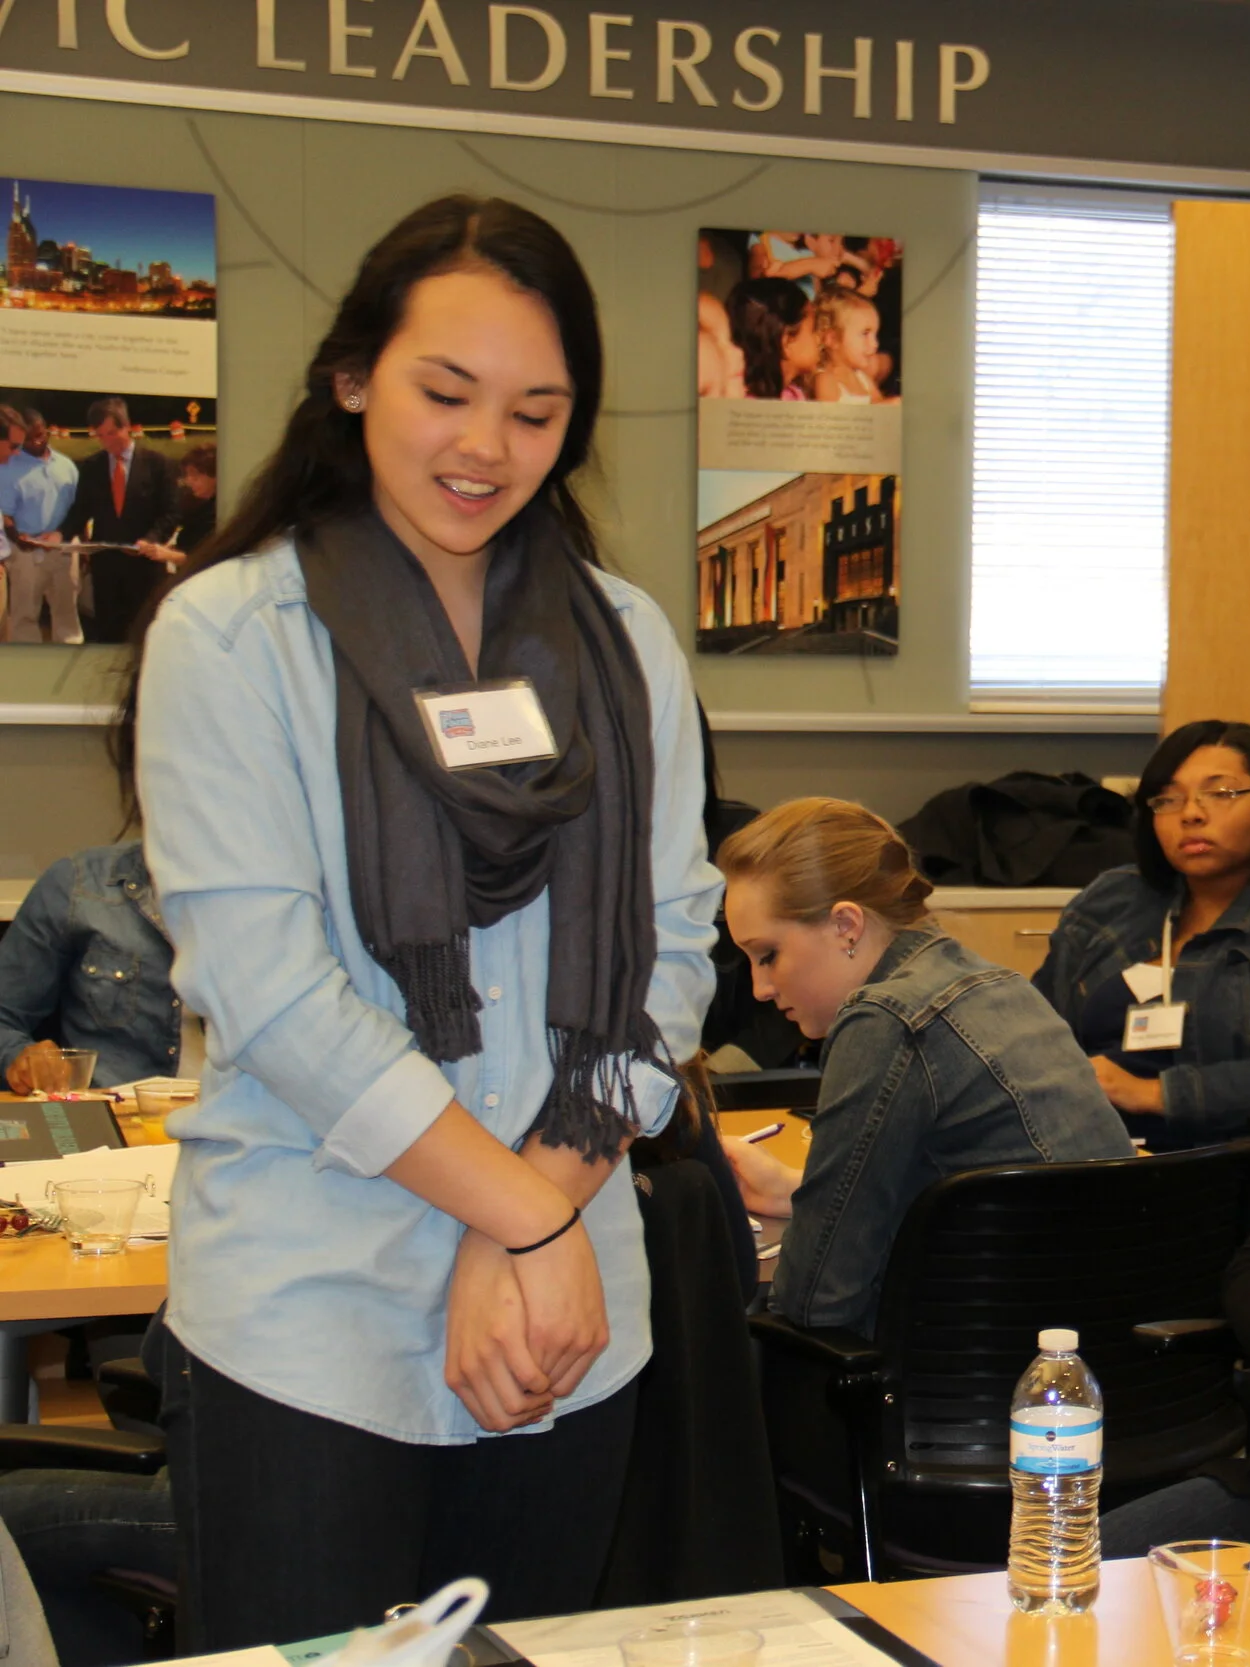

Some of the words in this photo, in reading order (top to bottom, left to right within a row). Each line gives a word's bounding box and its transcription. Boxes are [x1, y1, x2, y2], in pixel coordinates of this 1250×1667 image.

[0, 0, 190, 61] IC
[256, 0, 991, 125] LEADERSHIP
[467, 739, 499, 750] Diane
[502, 736, 523, 747] Lee
